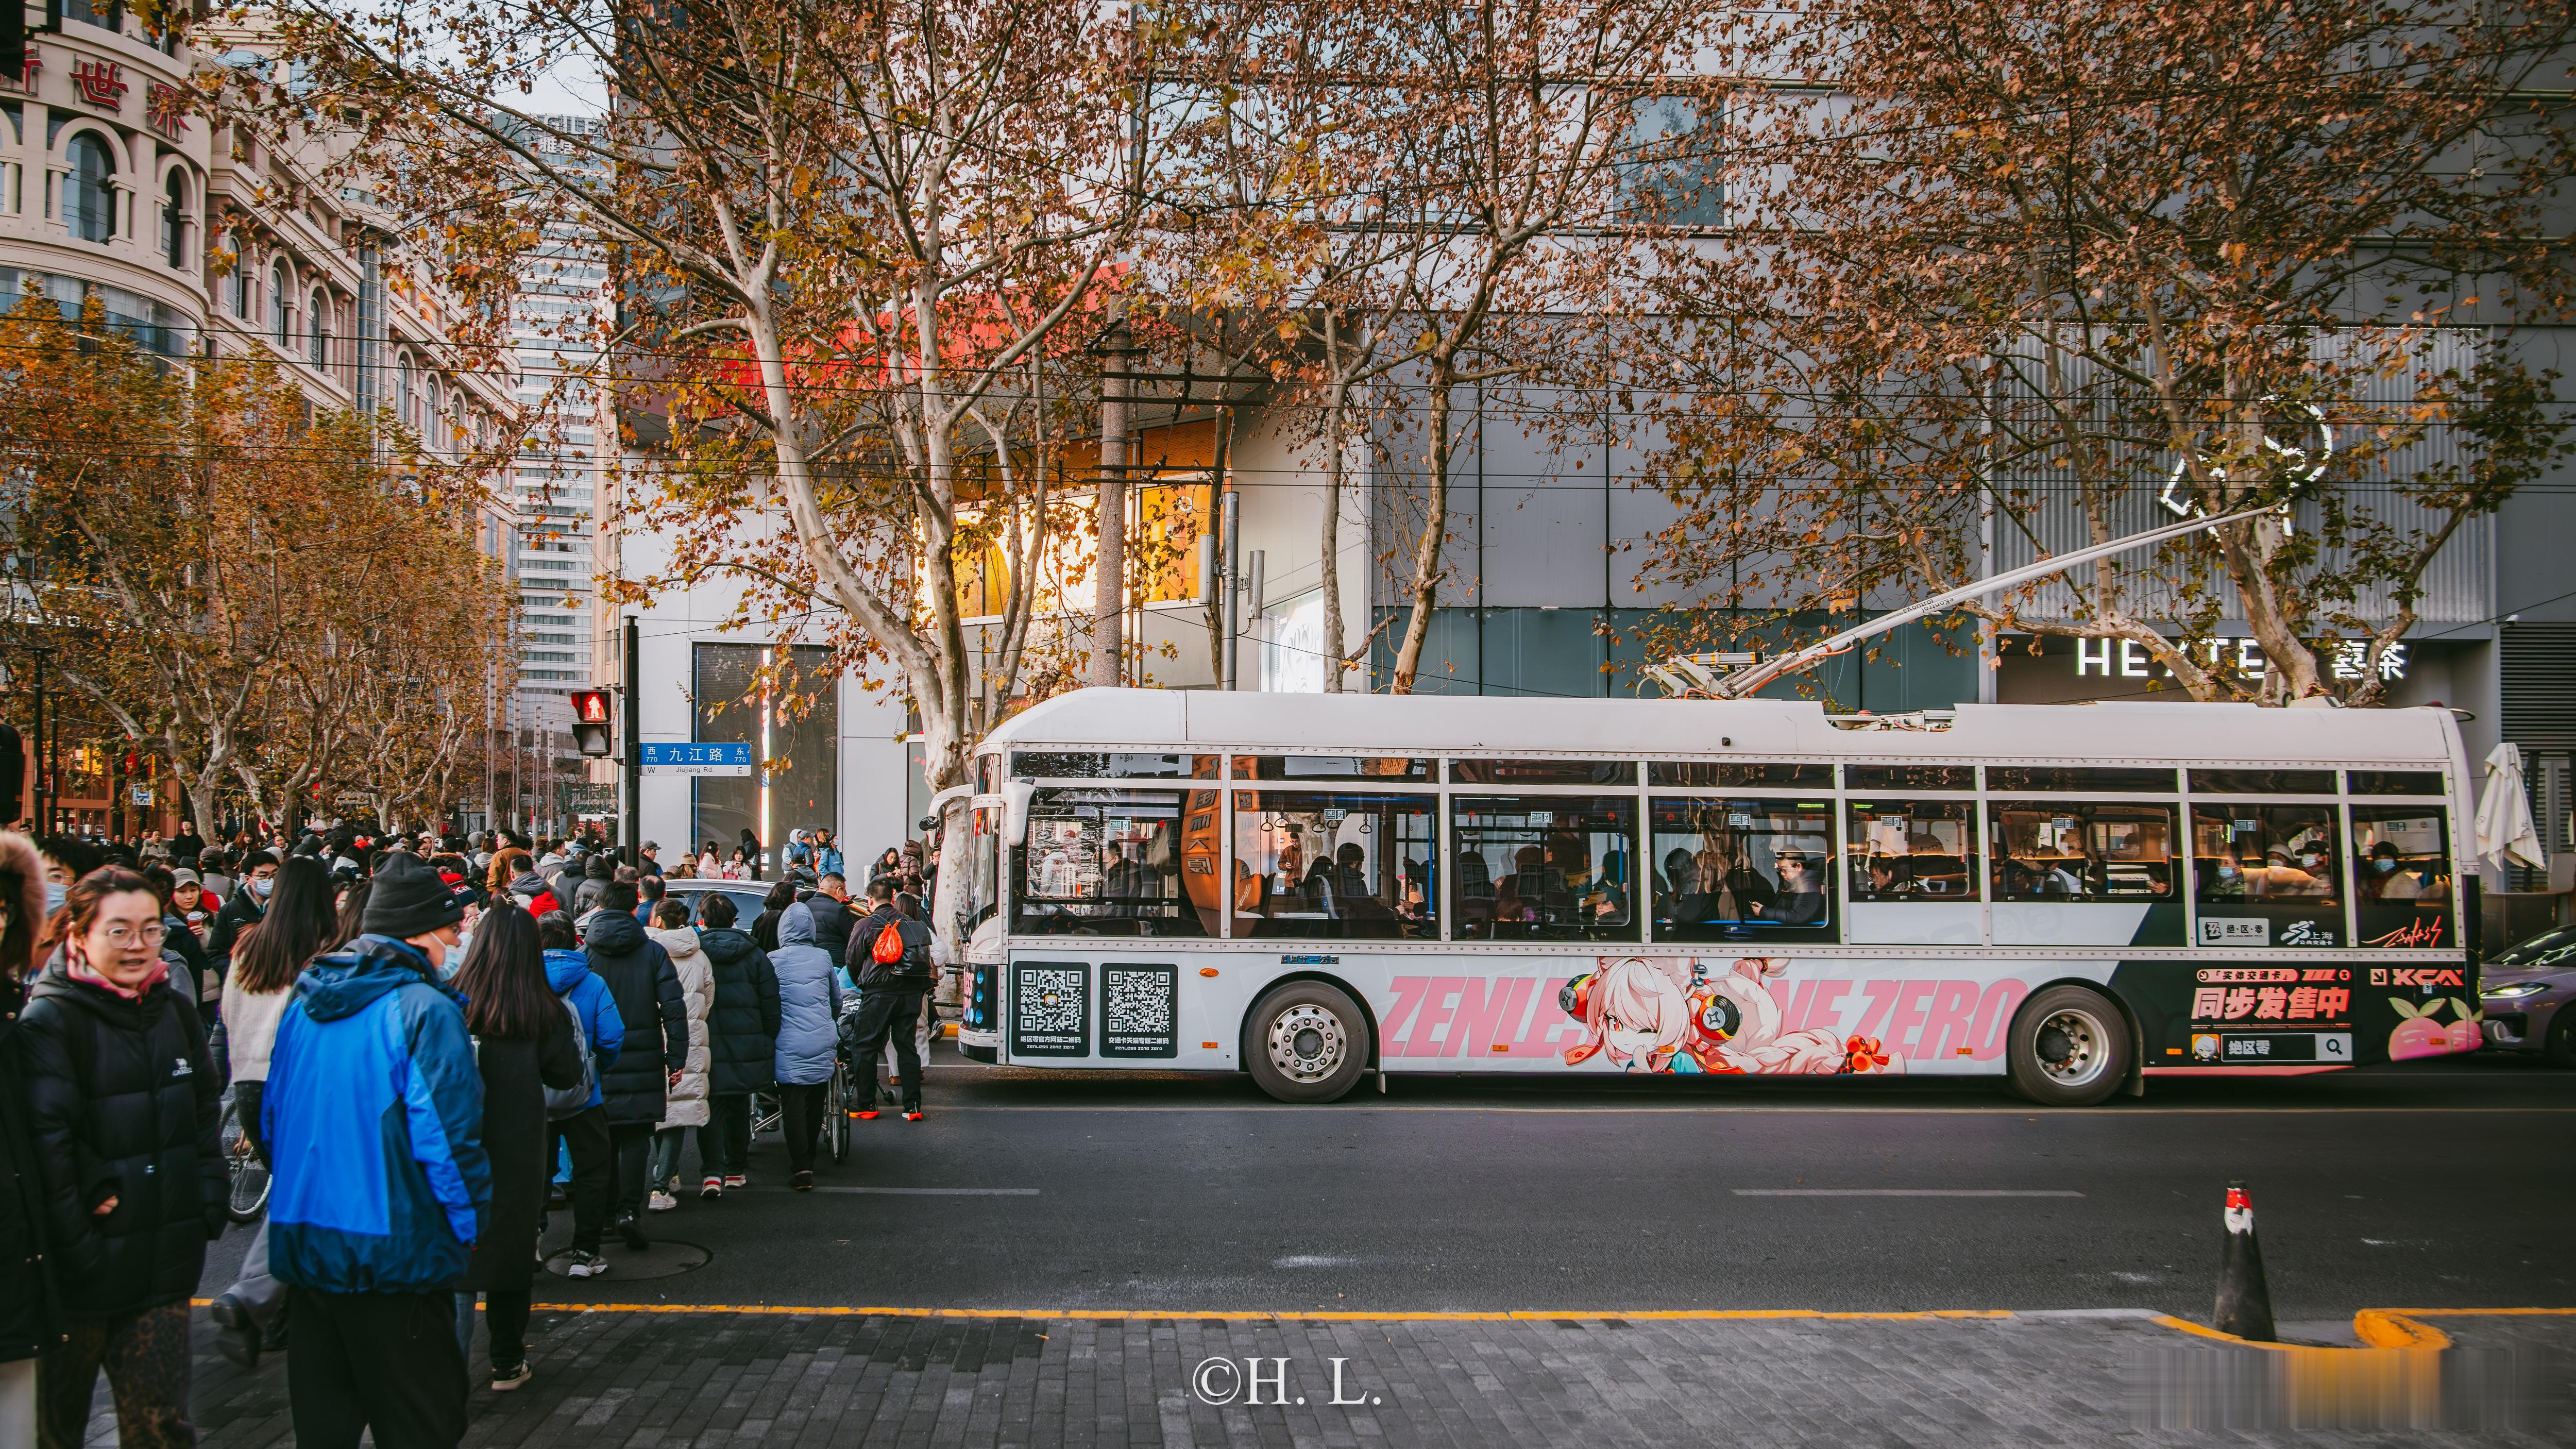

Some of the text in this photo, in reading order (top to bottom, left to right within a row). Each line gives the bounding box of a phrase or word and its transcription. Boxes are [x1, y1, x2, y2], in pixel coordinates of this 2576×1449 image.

[647, 747, 656, 755] 西
[669, 747, 723, 762] 九江路
[736, 747, 744, 755] 东
[2309, 932, 2333, 940] 上海
[2191, 986, 2351, 1020] 同步发售中
[1850, 978, 2029, 1062] ZERO
[2228, 1040, 2270, 1055] 绝区零
